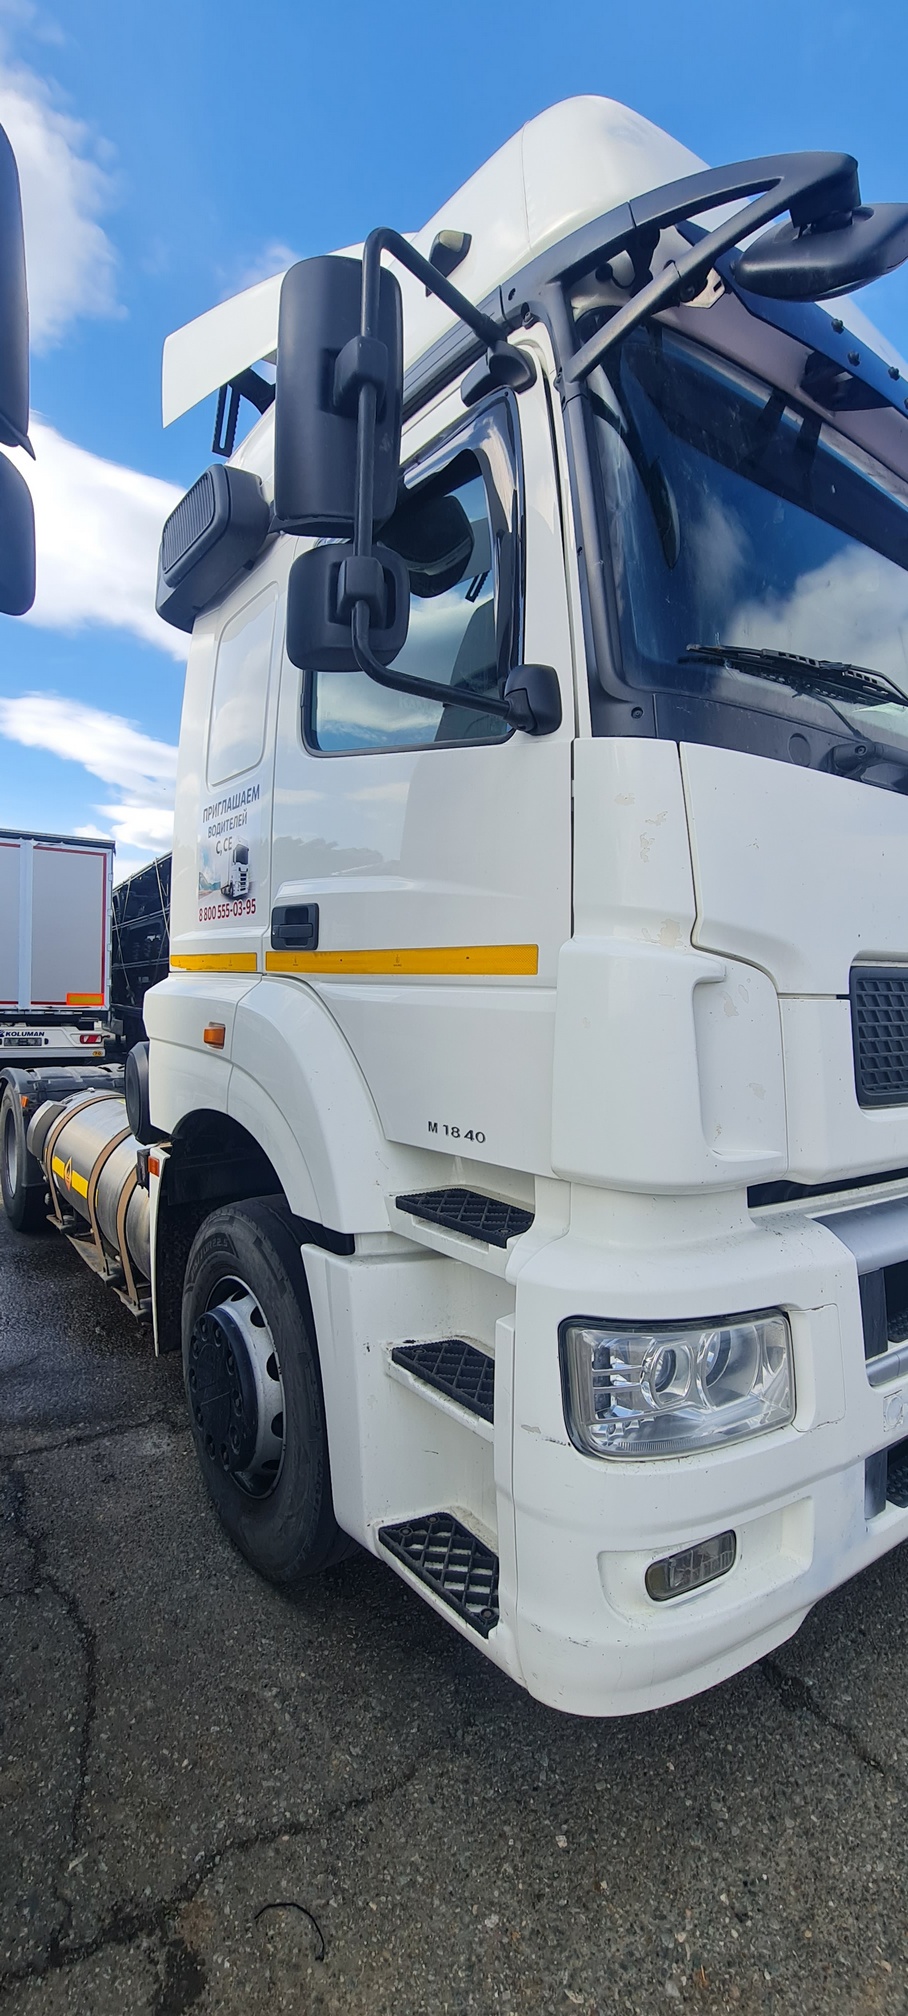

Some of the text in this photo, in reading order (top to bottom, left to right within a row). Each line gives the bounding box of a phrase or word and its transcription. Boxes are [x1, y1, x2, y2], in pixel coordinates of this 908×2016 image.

[202, 785, 260, 823] ПРИГЛАШАЕМ
[207, 808, 248, 838] ВОДИТЕЛЕЙ
[199, 898, 256, 921] 8 800 555-03-95
